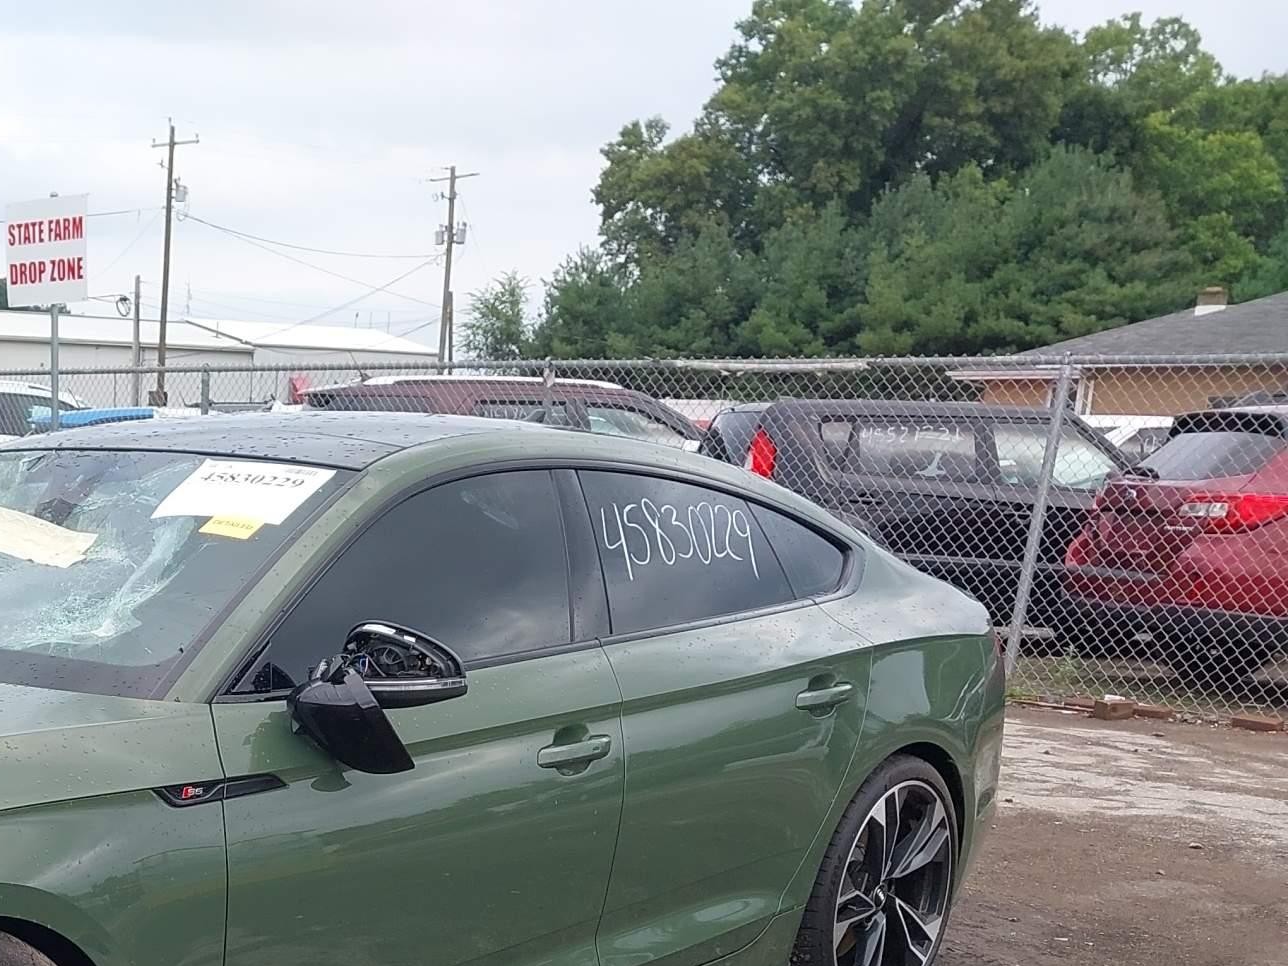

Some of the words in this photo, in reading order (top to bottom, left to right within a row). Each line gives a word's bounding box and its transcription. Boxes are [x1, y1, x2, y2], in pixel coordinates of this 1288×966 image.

[8, 221, 45, 246] STATE
[48, 216, 83, 242] FARM
[9, 261, 46, 286] DROP
[50, 257, 83, 282] ZONE
[200, 471, 306, 488] 45830229
[600, 498, 760, 581] 45830229
